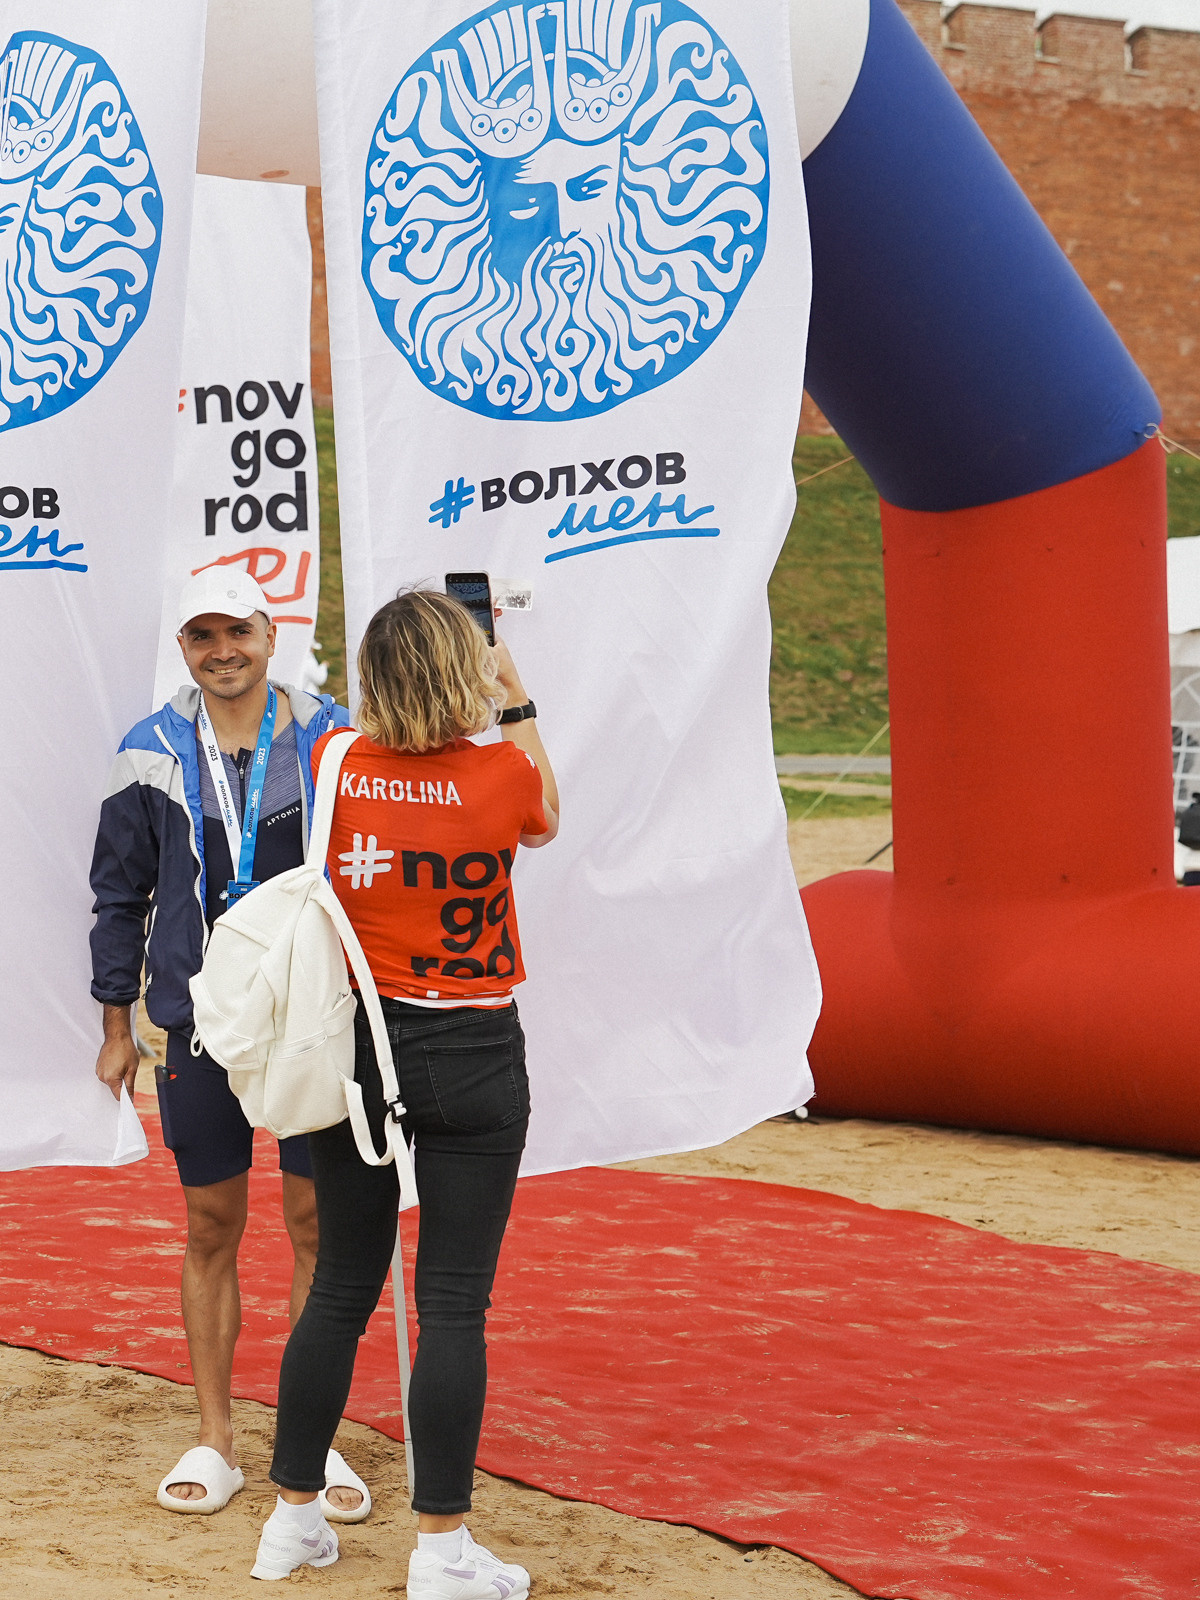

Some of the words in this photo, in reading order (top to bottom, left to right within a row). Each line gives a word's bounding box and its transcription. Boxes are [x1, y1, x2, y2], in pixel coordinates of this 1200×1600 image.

[178, 380, 304, 424] nov
[231, 428, 307, 488] go
[204, 470, 309, 536] rod
[428, 451, 687, 529] #ВОЛХОВ
[547, 491, 715, 540] мен
[208, 744, 219, 762] 2023
[256, 747, 266, 766] 2023
[340, 771, 462, 806] KAROLINA
[266, 806, 301, 827] APTONIA
[440, 886, 510, 954] go
